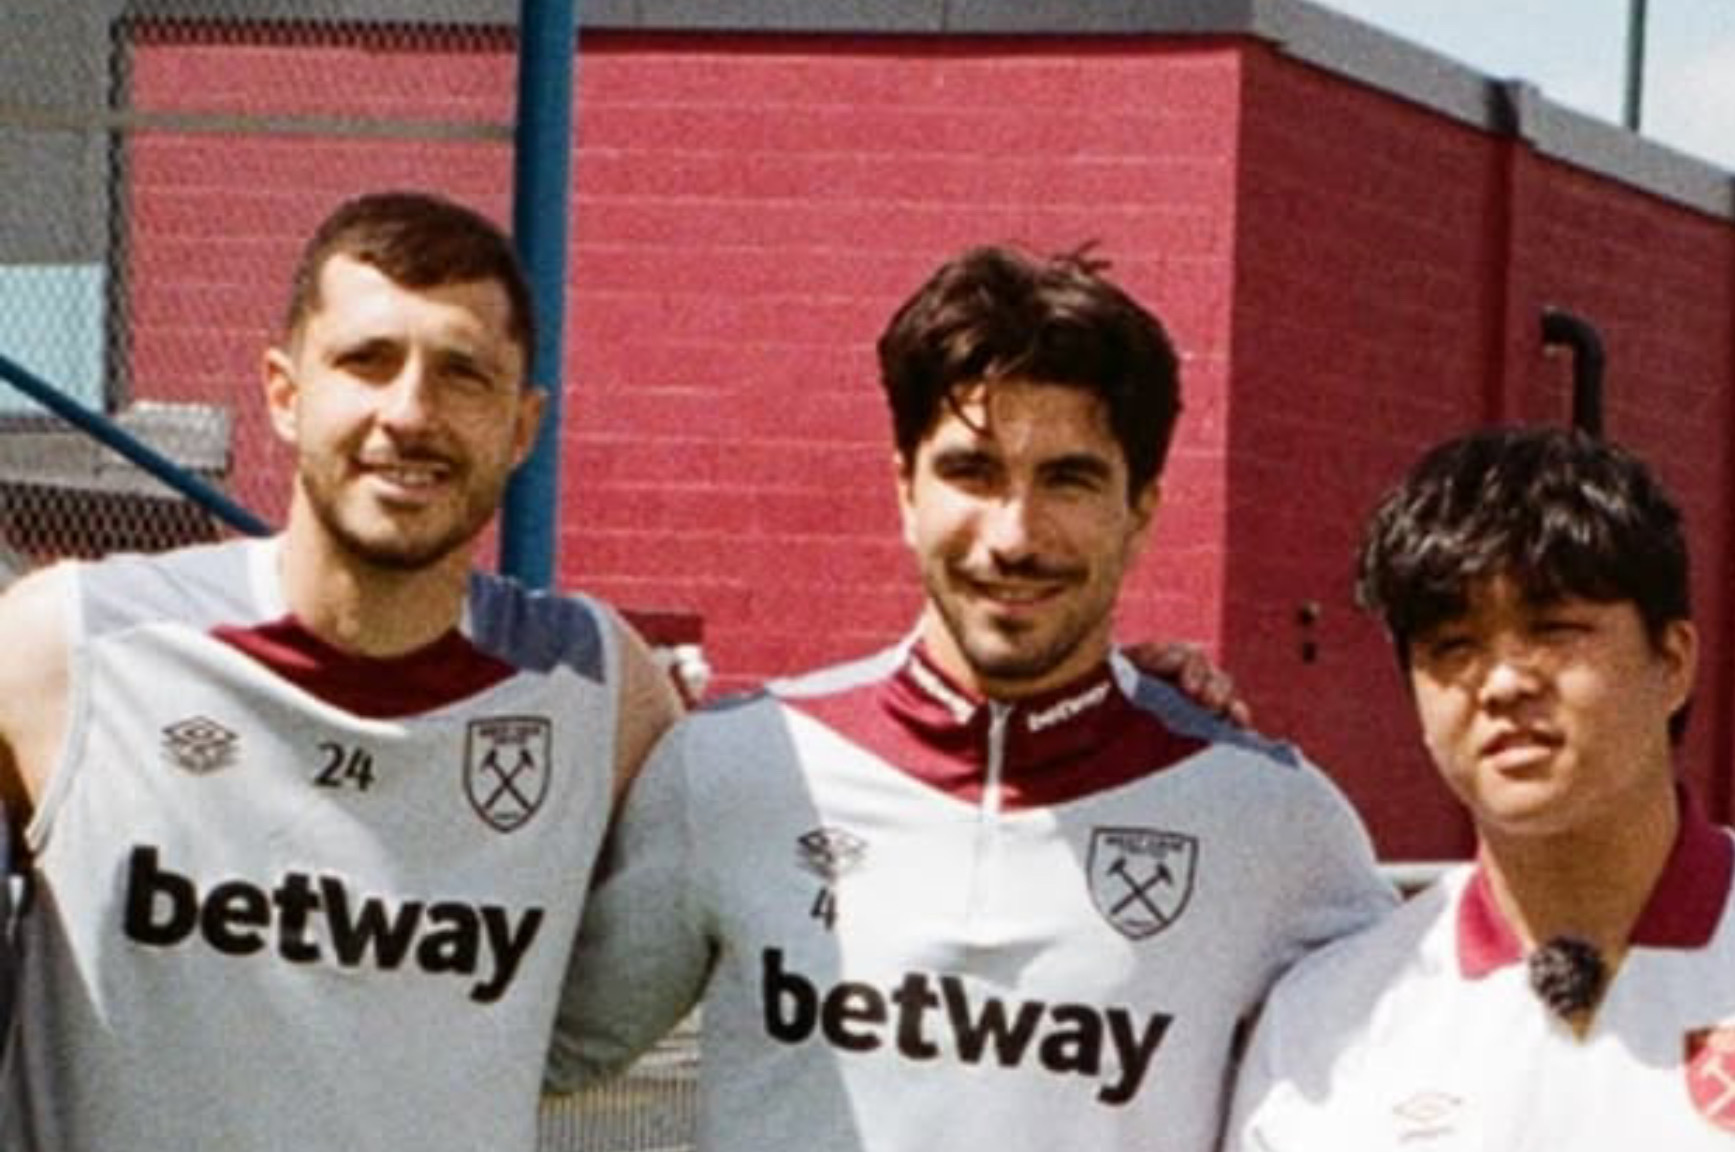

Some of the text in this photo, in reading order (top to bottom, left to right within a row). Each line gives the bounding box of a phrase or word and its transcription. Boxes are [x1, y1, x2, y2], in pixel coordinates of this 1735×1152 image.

[314, 742, 374, 791] 24
[123, 845, 545, 1003] betway
[810, 886, 838, 932] 4
[763, 947, 1174, 1106] betway
